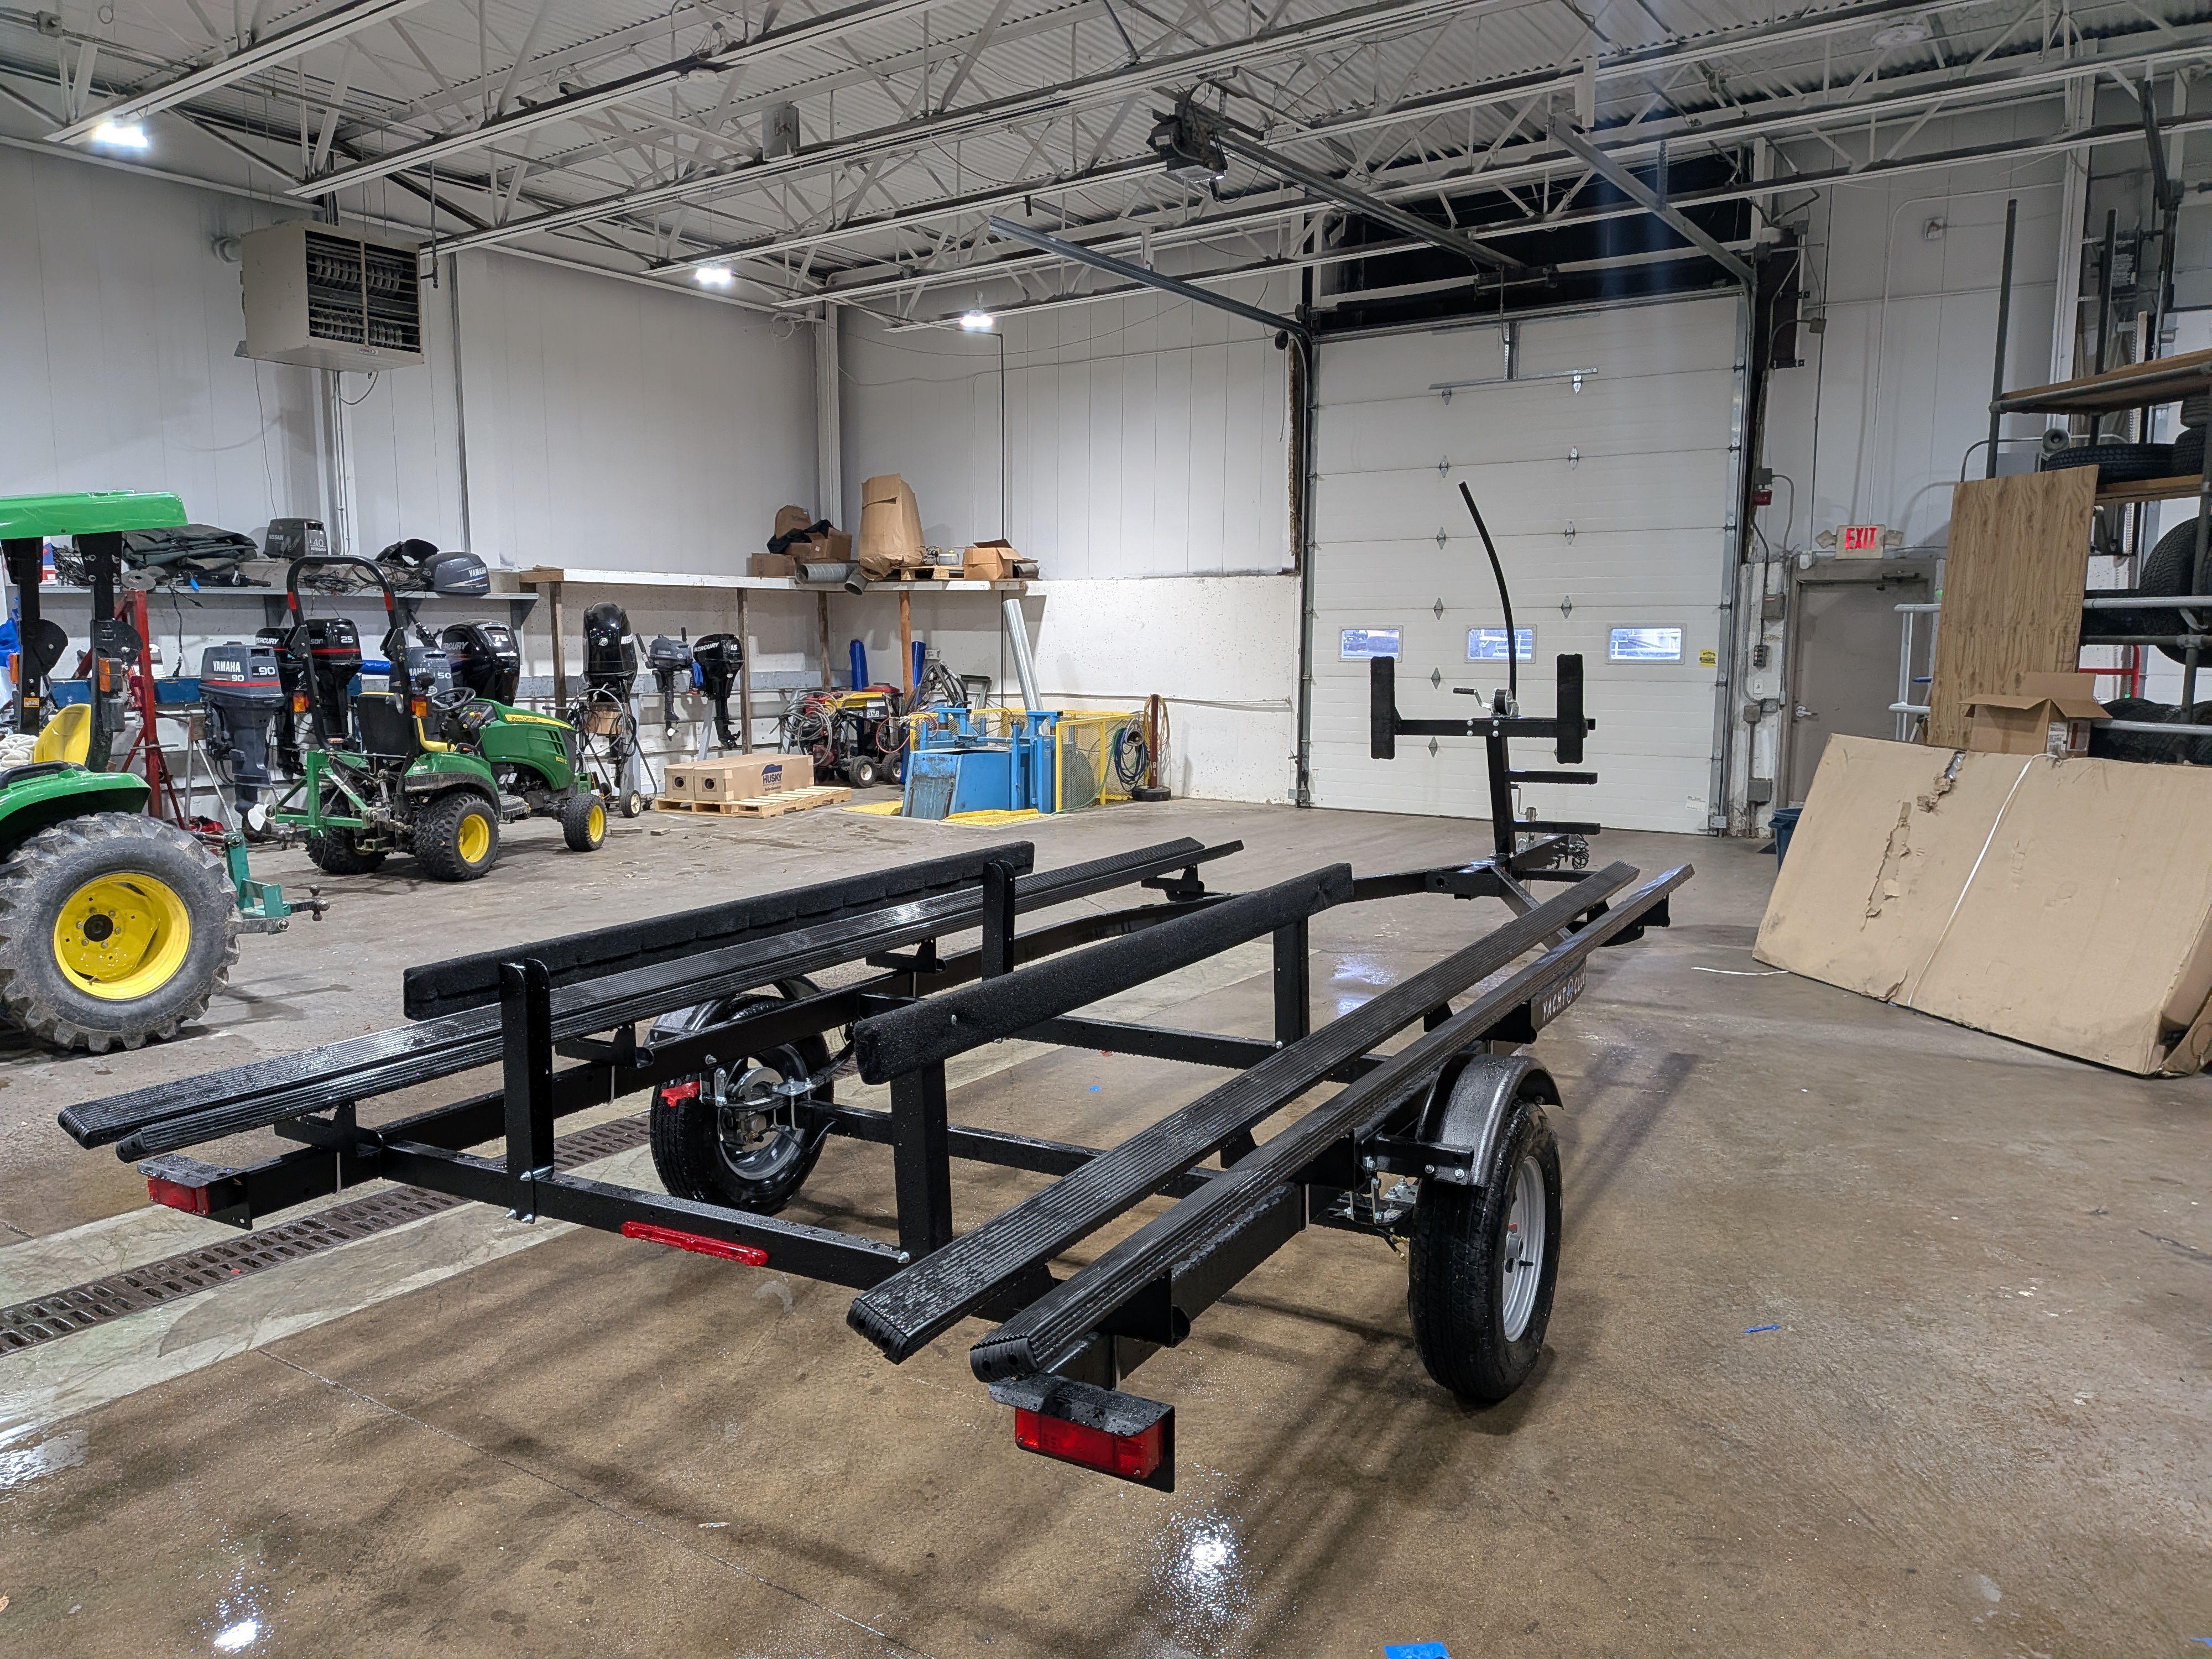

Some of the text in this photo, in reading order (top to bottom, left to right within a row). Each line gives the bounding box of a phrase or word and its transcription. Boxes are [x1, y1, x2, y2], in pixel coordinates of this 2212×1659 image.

[313, 538, 325, 546] 40
[1845, 527, 1877, 549] EXIT
[468, 566, 487, 577] YAMAHA
[340, 635, 354, 644] 25
[693, 641, 720, 653] MERCURY
[212, 660, 242, 673] YAMAHA
[258, 666, 276, 676] 90
[231, 674, 245, 682] 90
[763, 772, 782, 784] HUSKY
[1543, 987, 1567, 1021] YACHT
